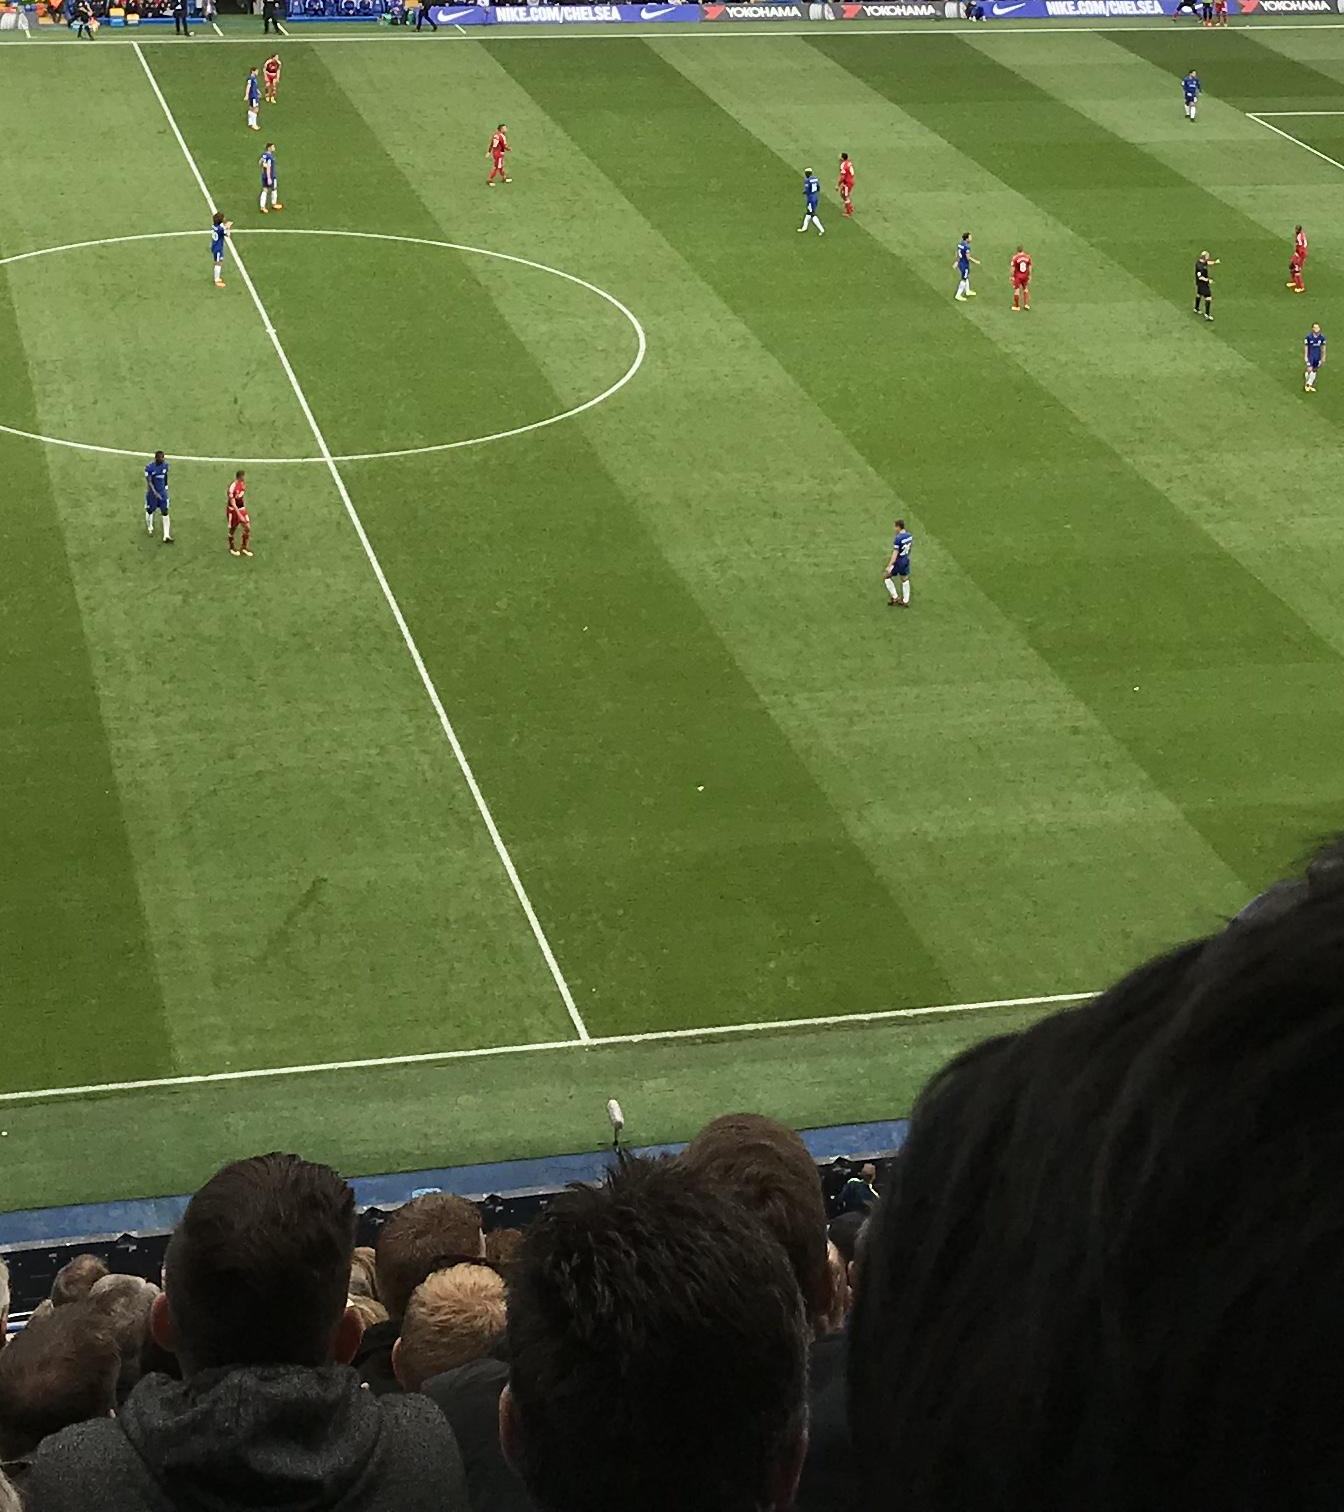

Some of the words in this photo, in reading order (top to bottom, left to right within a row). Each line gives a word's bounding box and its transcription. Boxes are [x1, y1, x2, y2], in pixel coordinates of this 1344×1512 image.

[725, 6, 802, 18] YOKOHAMA
[862, 4, 936, 16] YOKOHAMA
[1045, 0, 1164, 16] NIKE.COM/CHELSEA
[1259, 0, 1331, 12] YOKOHAMA
[495, 6, 622, 24] NIKE.COM/CHELSEA
